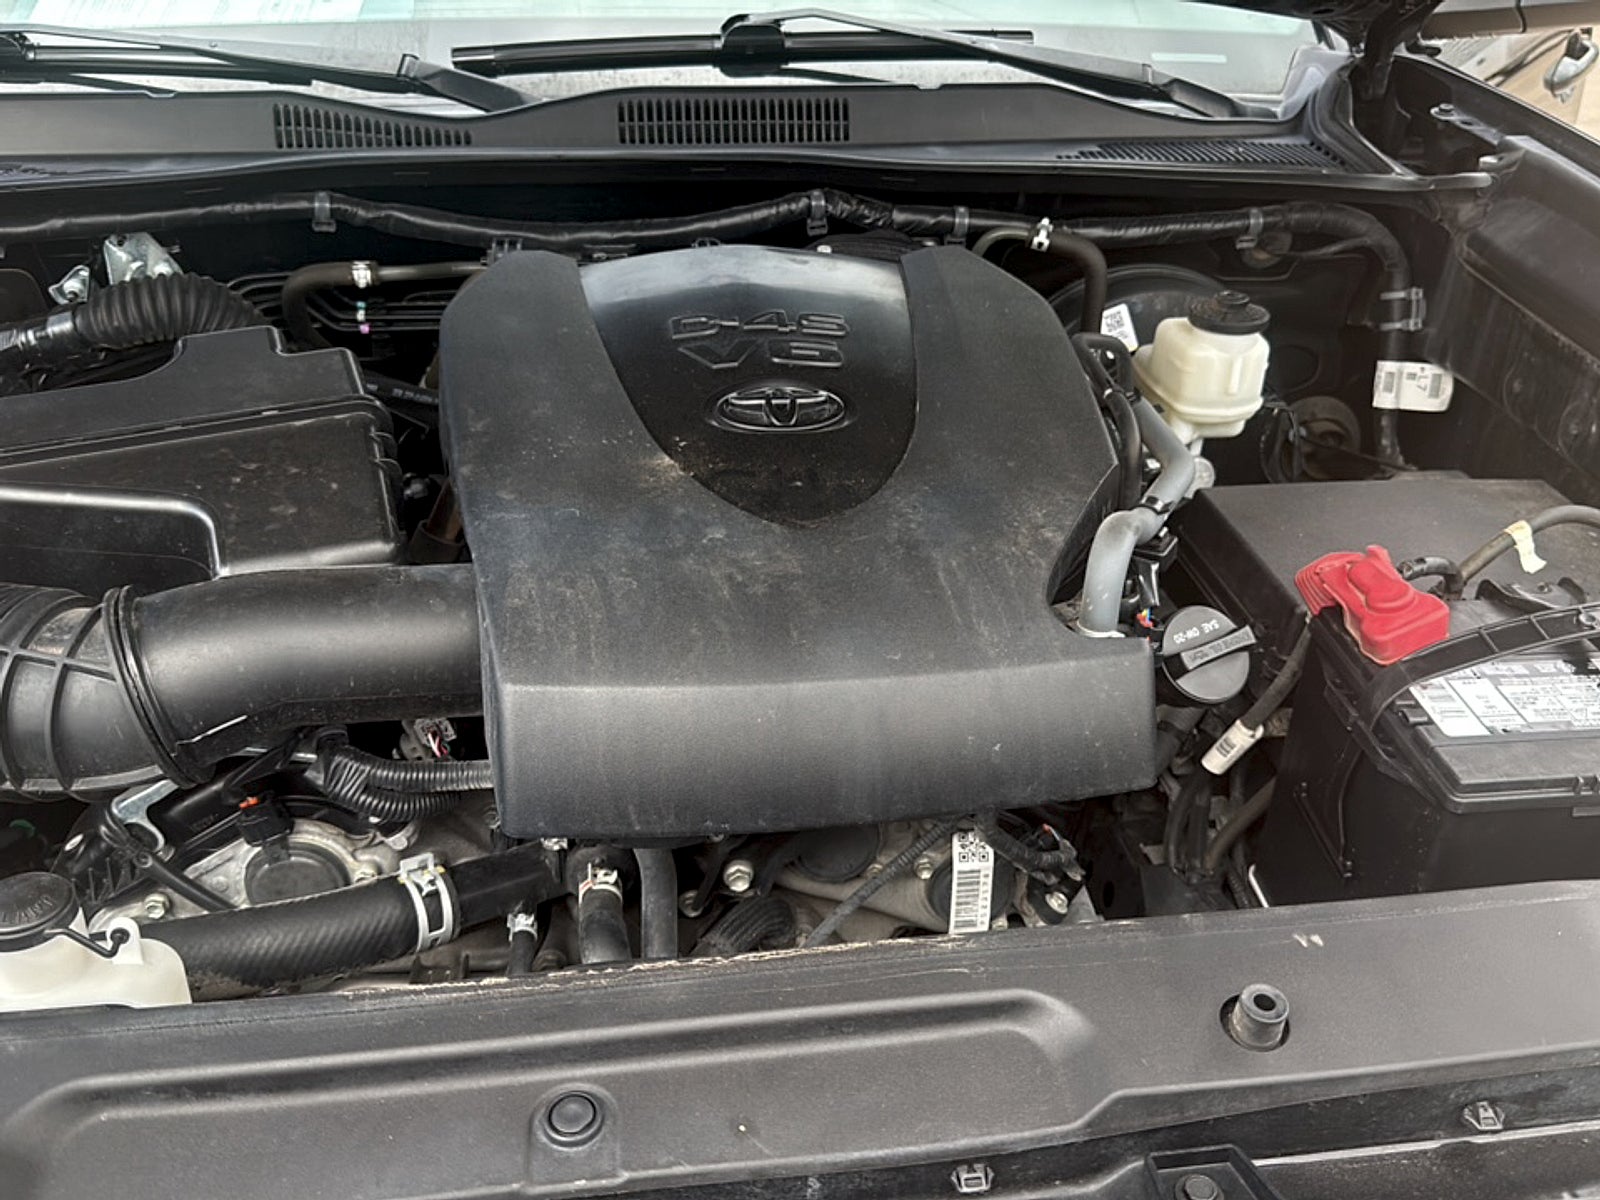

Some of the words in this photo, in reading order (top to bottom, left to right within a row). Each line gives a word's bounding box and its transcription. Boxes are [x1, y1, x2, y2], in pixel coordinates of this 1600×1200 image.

[669, 309, 850, 340] D-4S
[677, 336, 844, 370] V6
[1201, 619, 1220, 634] SAE
